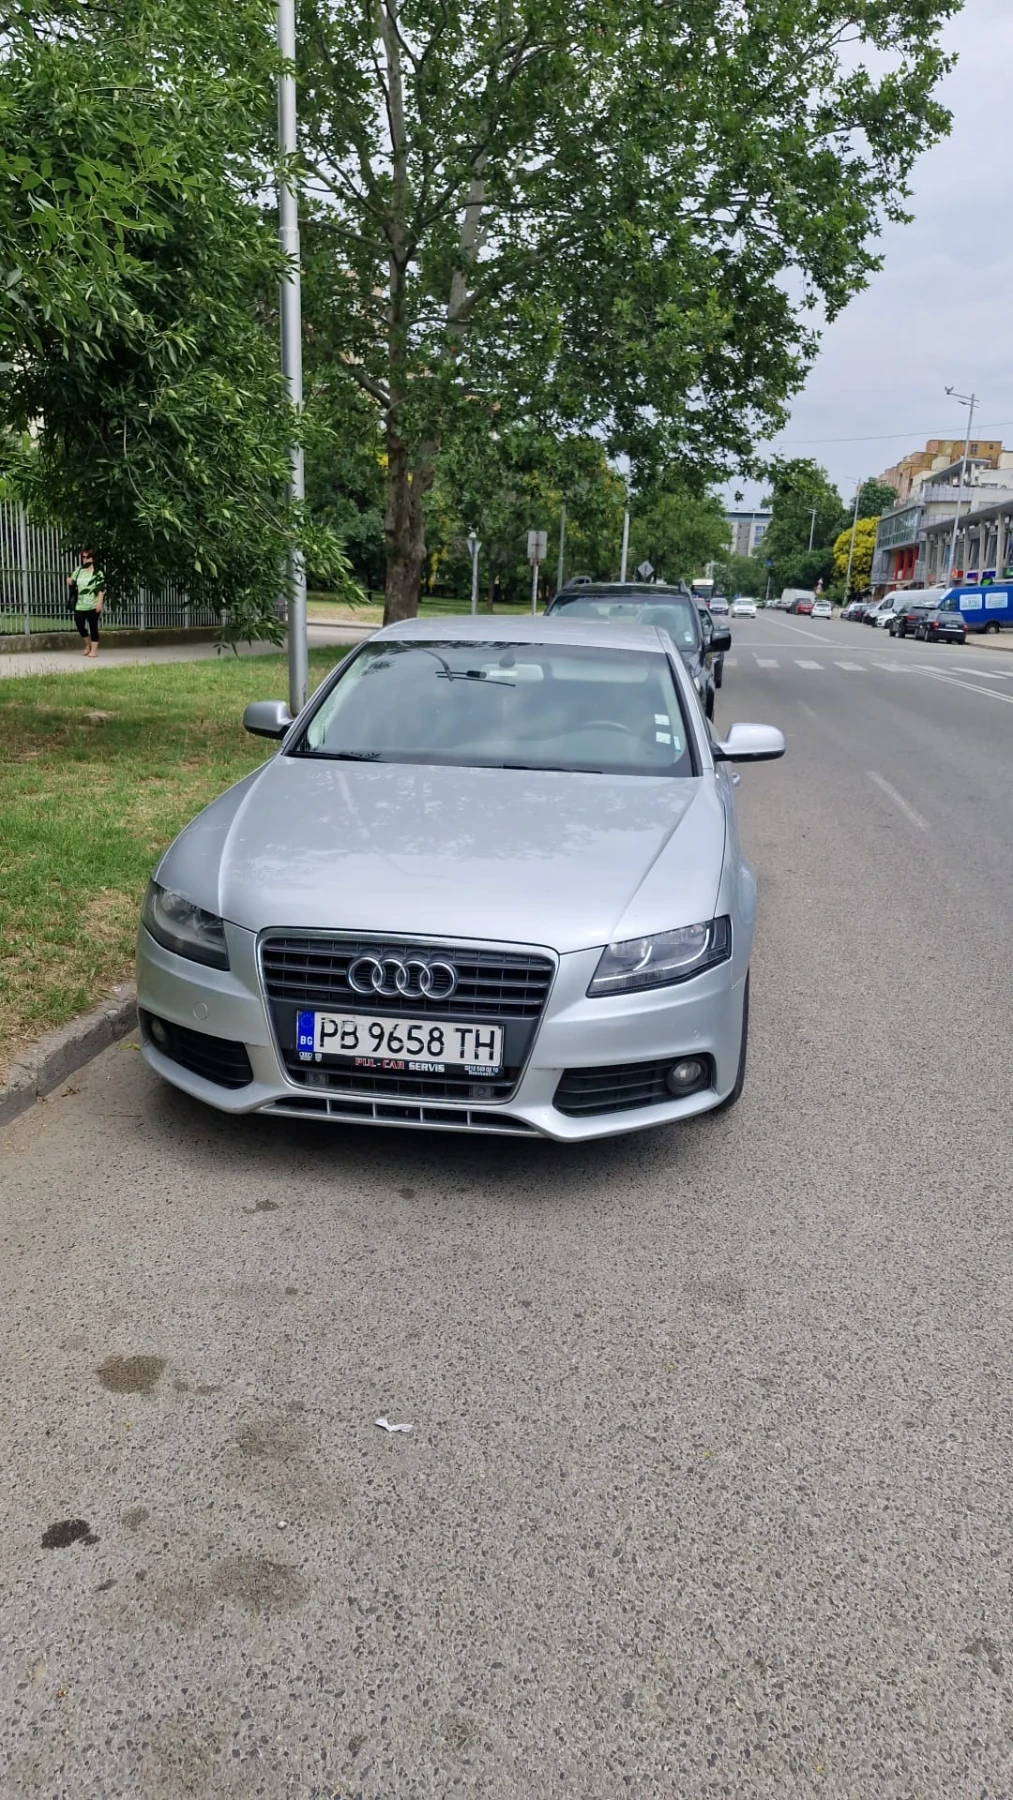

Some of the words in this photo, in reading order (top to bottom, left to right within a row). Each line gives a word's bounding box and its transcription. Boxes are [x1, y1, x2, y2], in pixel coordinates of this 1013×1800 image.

[300, 1036, 313, 1046] BG
[319, 1017, 359, 1049] PB
[368, 1022, 445, 1056] 9658
[455, 1027, 495, 1060] TH
